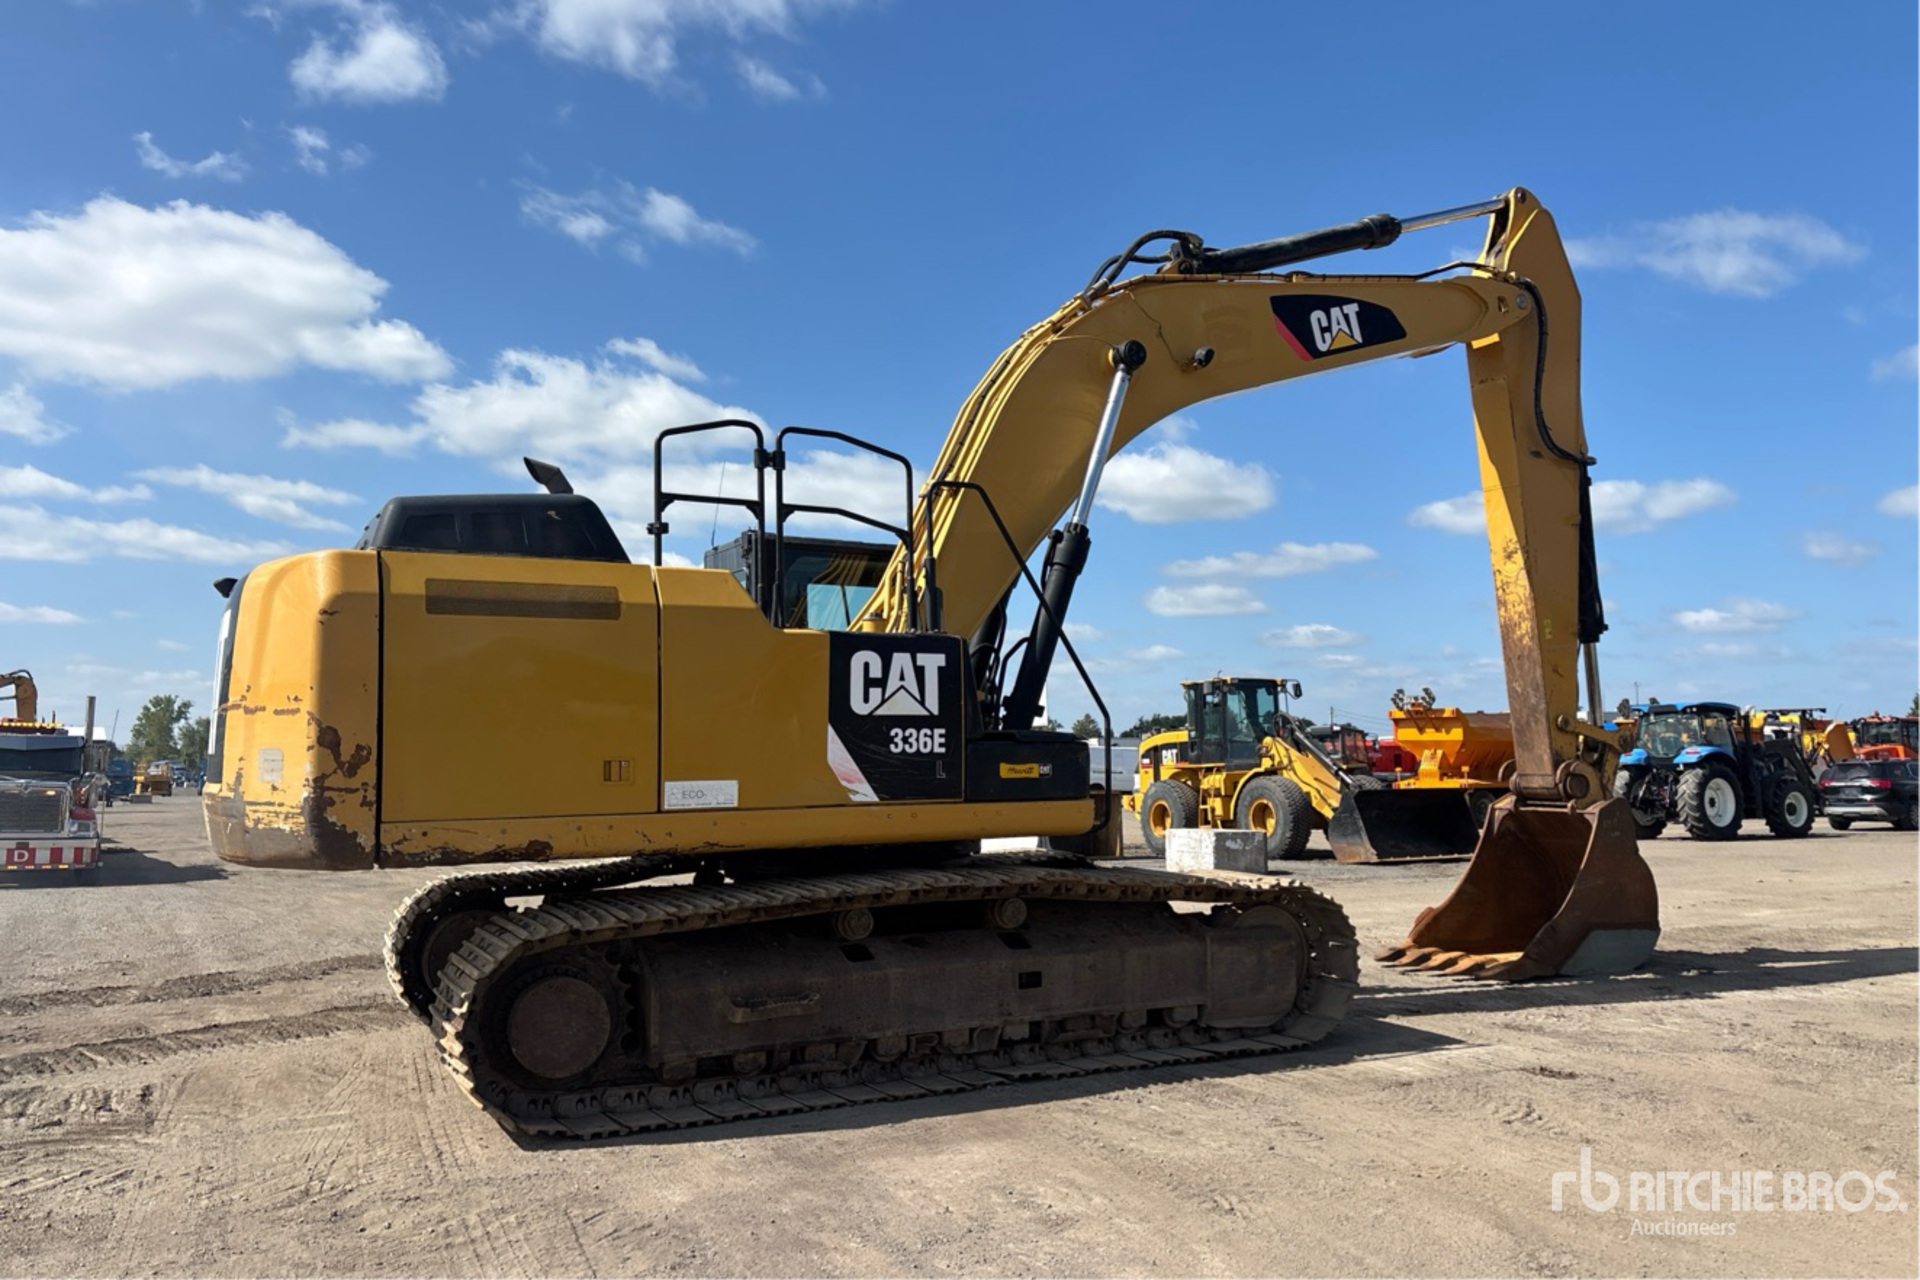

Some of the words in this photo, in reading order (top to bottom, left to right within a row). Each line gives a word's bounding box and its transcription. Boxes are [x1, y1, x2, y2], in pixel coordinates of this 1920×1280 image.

[1310, 303, 1363, 352] CAT
[850, 650, 946, 716] CAT
[889, 728, 946, 753] 336E
[936, 760, 946, 778] L
[14, 850, 29, 862] D
